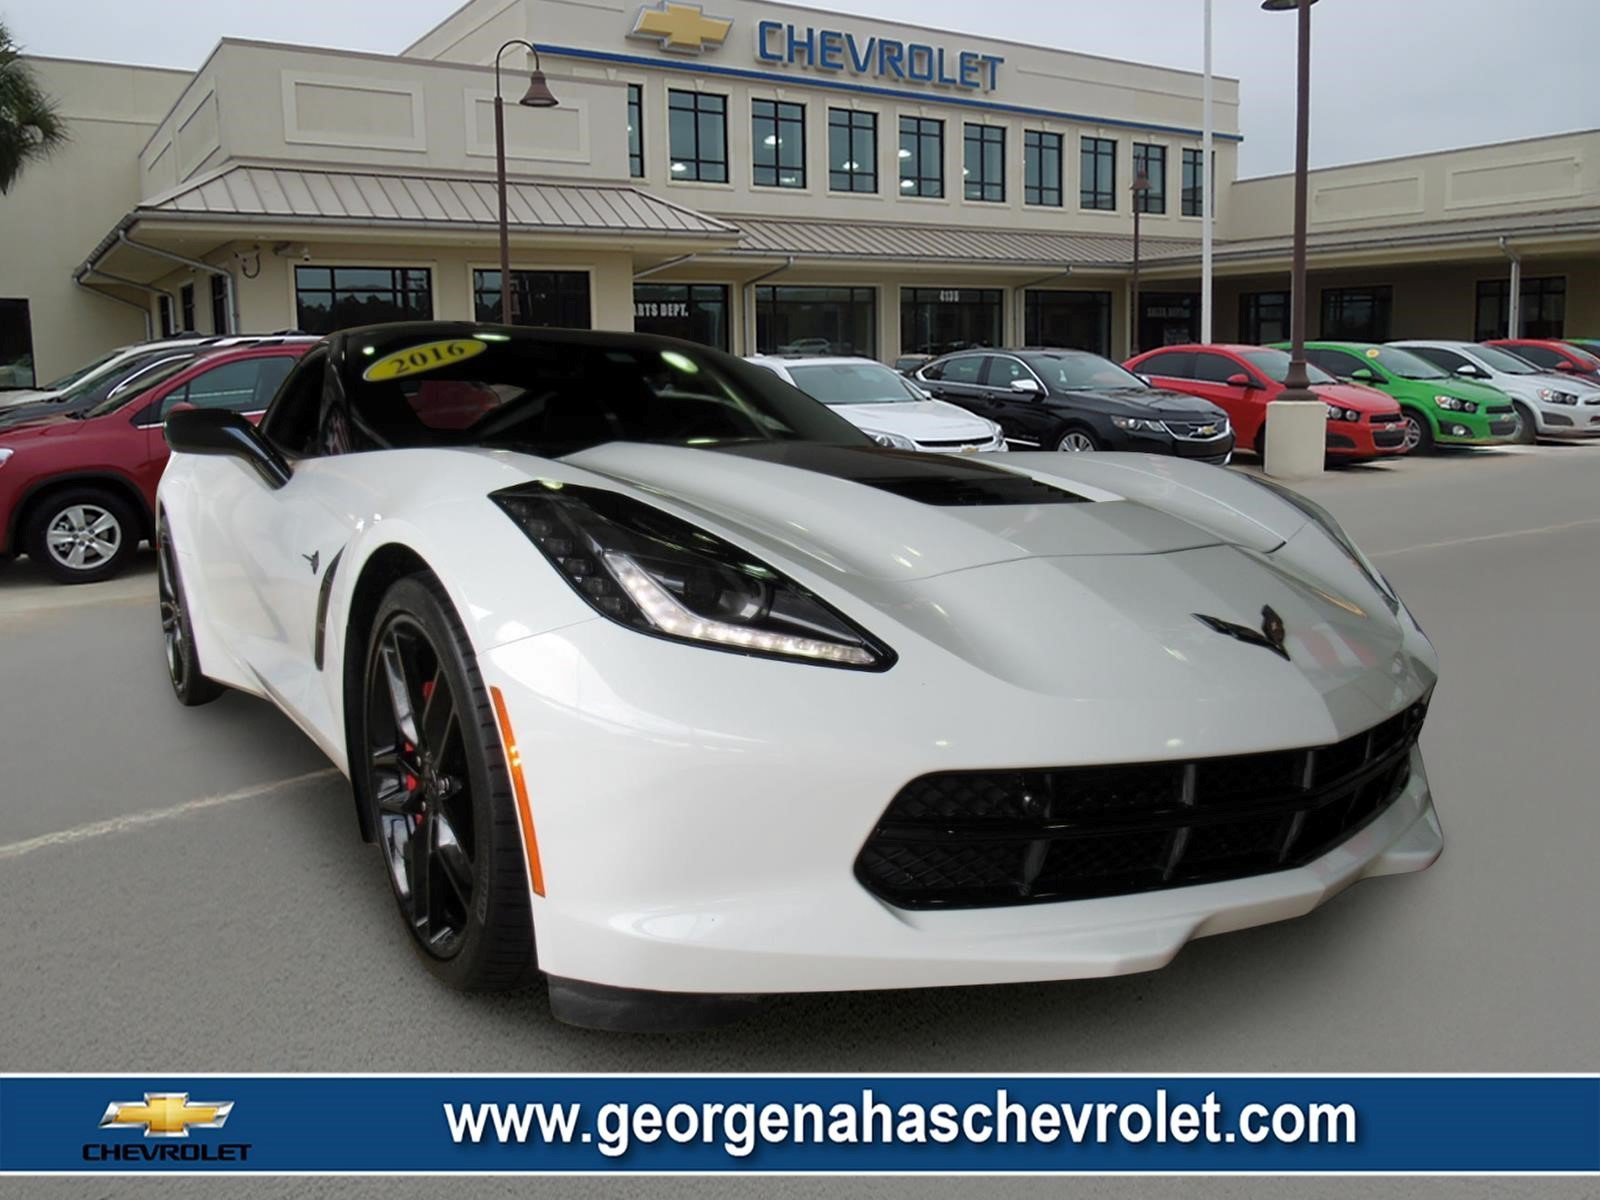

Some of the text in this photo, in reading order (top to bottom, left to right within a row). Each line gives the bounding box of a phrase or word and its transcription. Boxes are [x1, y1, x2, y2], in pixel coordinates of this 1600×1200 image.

[757, 20, 1005, 91] CHEVROLET
[660, 303, 689, 317] DEPT.
[390, 342, 465, 375] 2016
